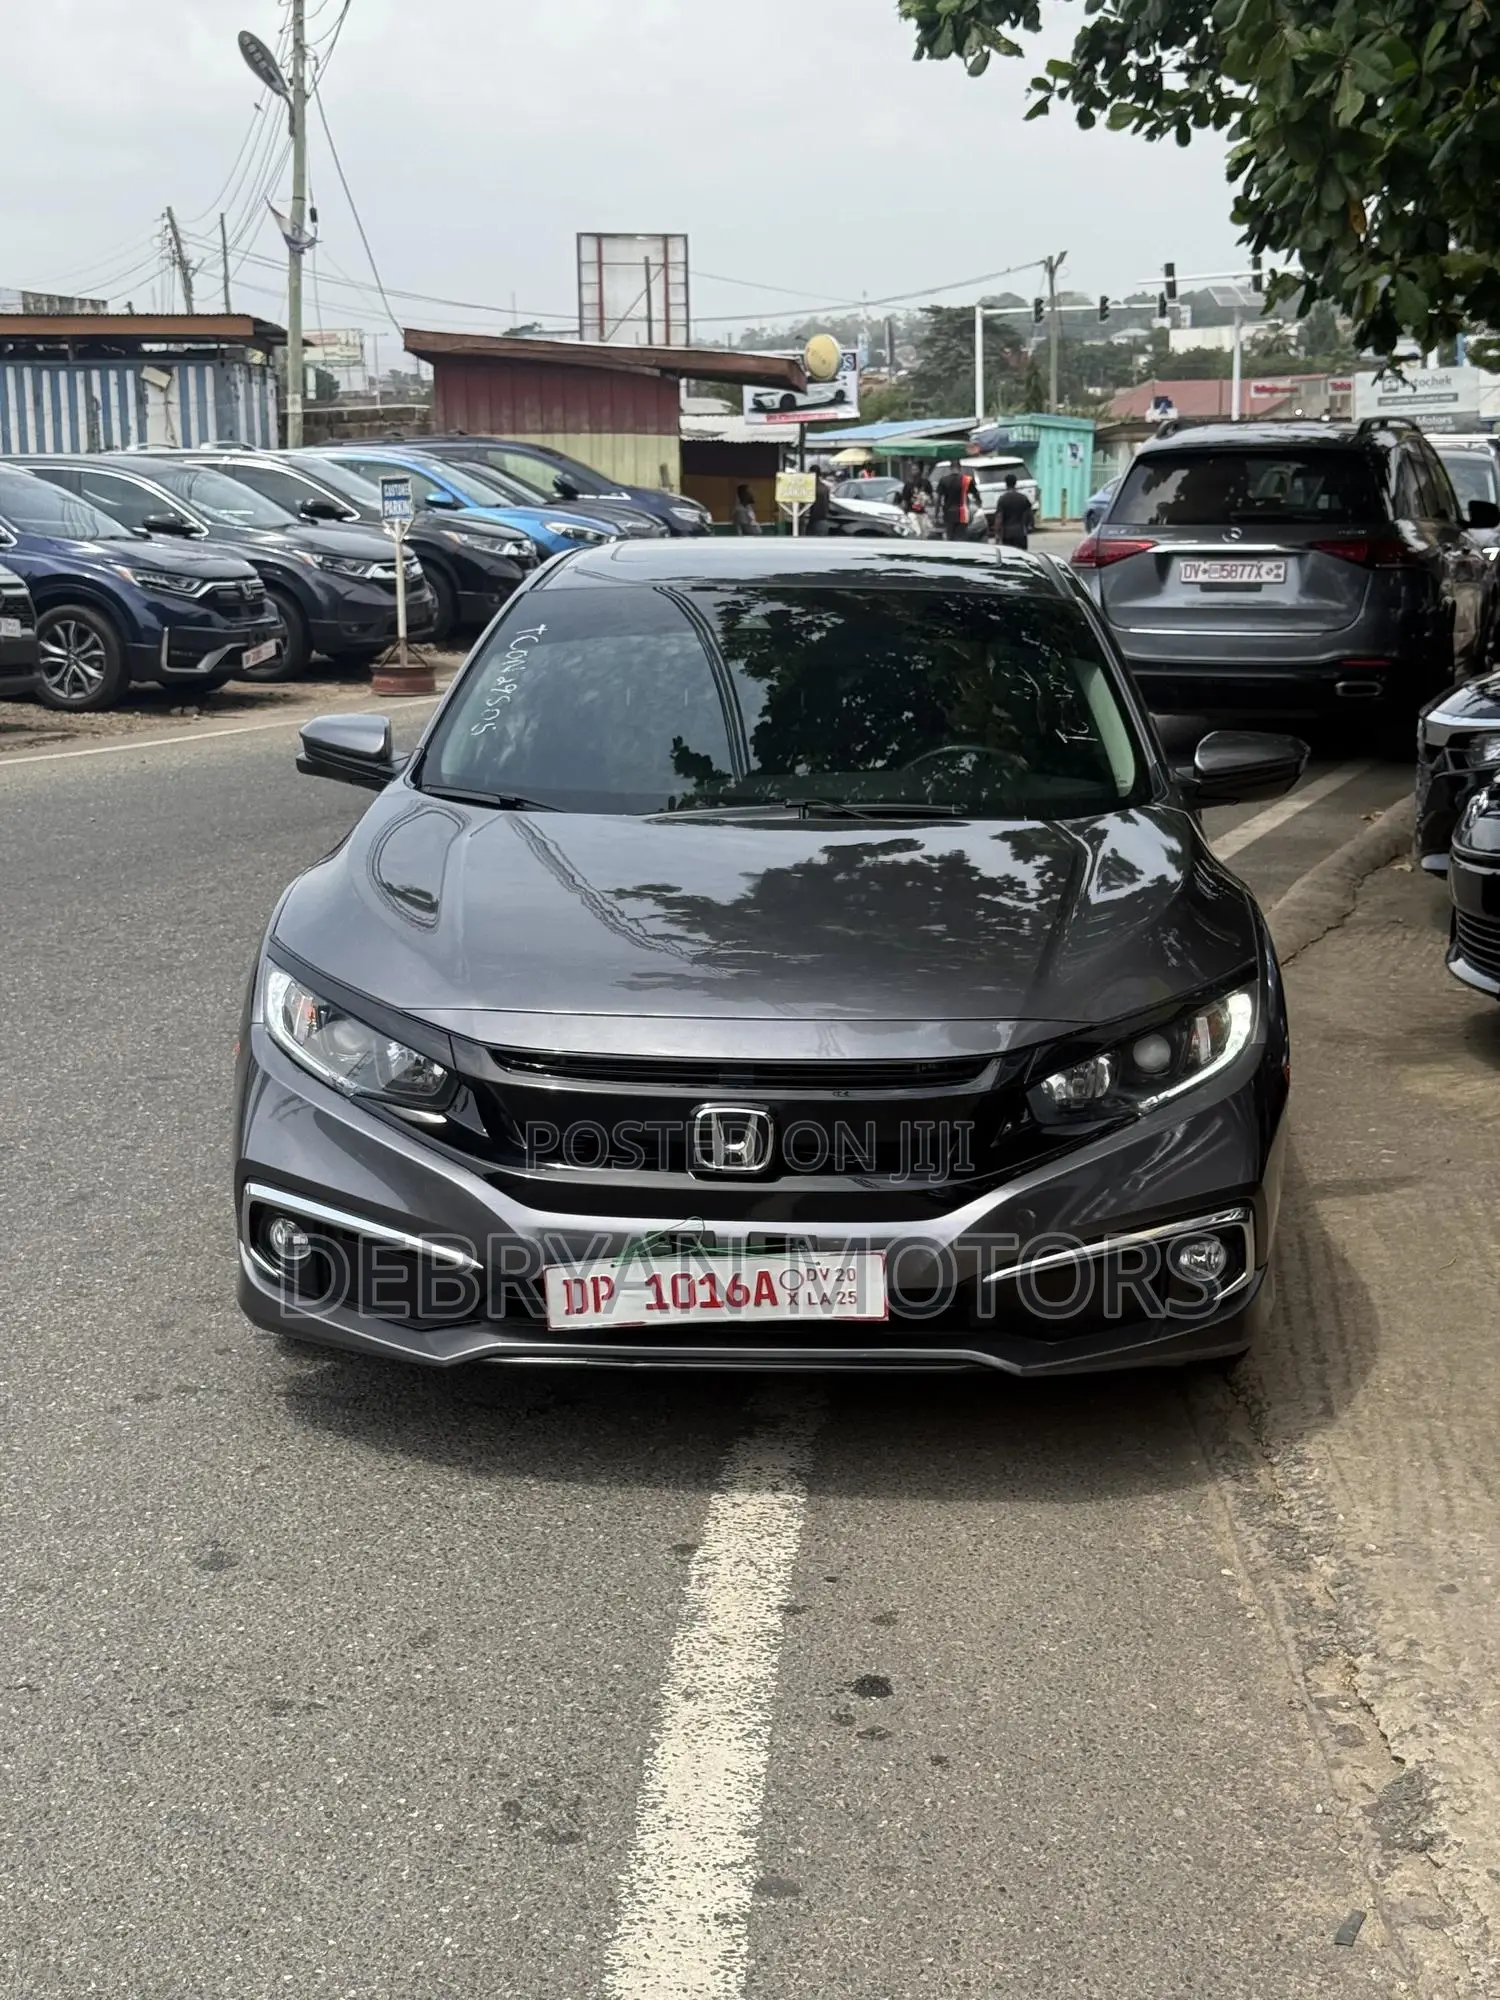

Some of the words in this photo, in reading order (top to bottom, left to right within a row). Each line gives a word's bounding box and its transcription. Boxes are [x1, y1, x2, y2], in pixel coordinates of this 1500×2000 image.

[1183, 563, 1200, 579] DV
[1220, 563, 1263, 580] 5877X
[806, 1267, 830, 1282] DV
[835, 1267, 857, 1282] 20
[562, 1276, 615, 1316] DP
[644, 1269, 779, 1311] 1016A
[807, 1291, 832, 1306] LA
[836, 1290, 858, 1306] 25
